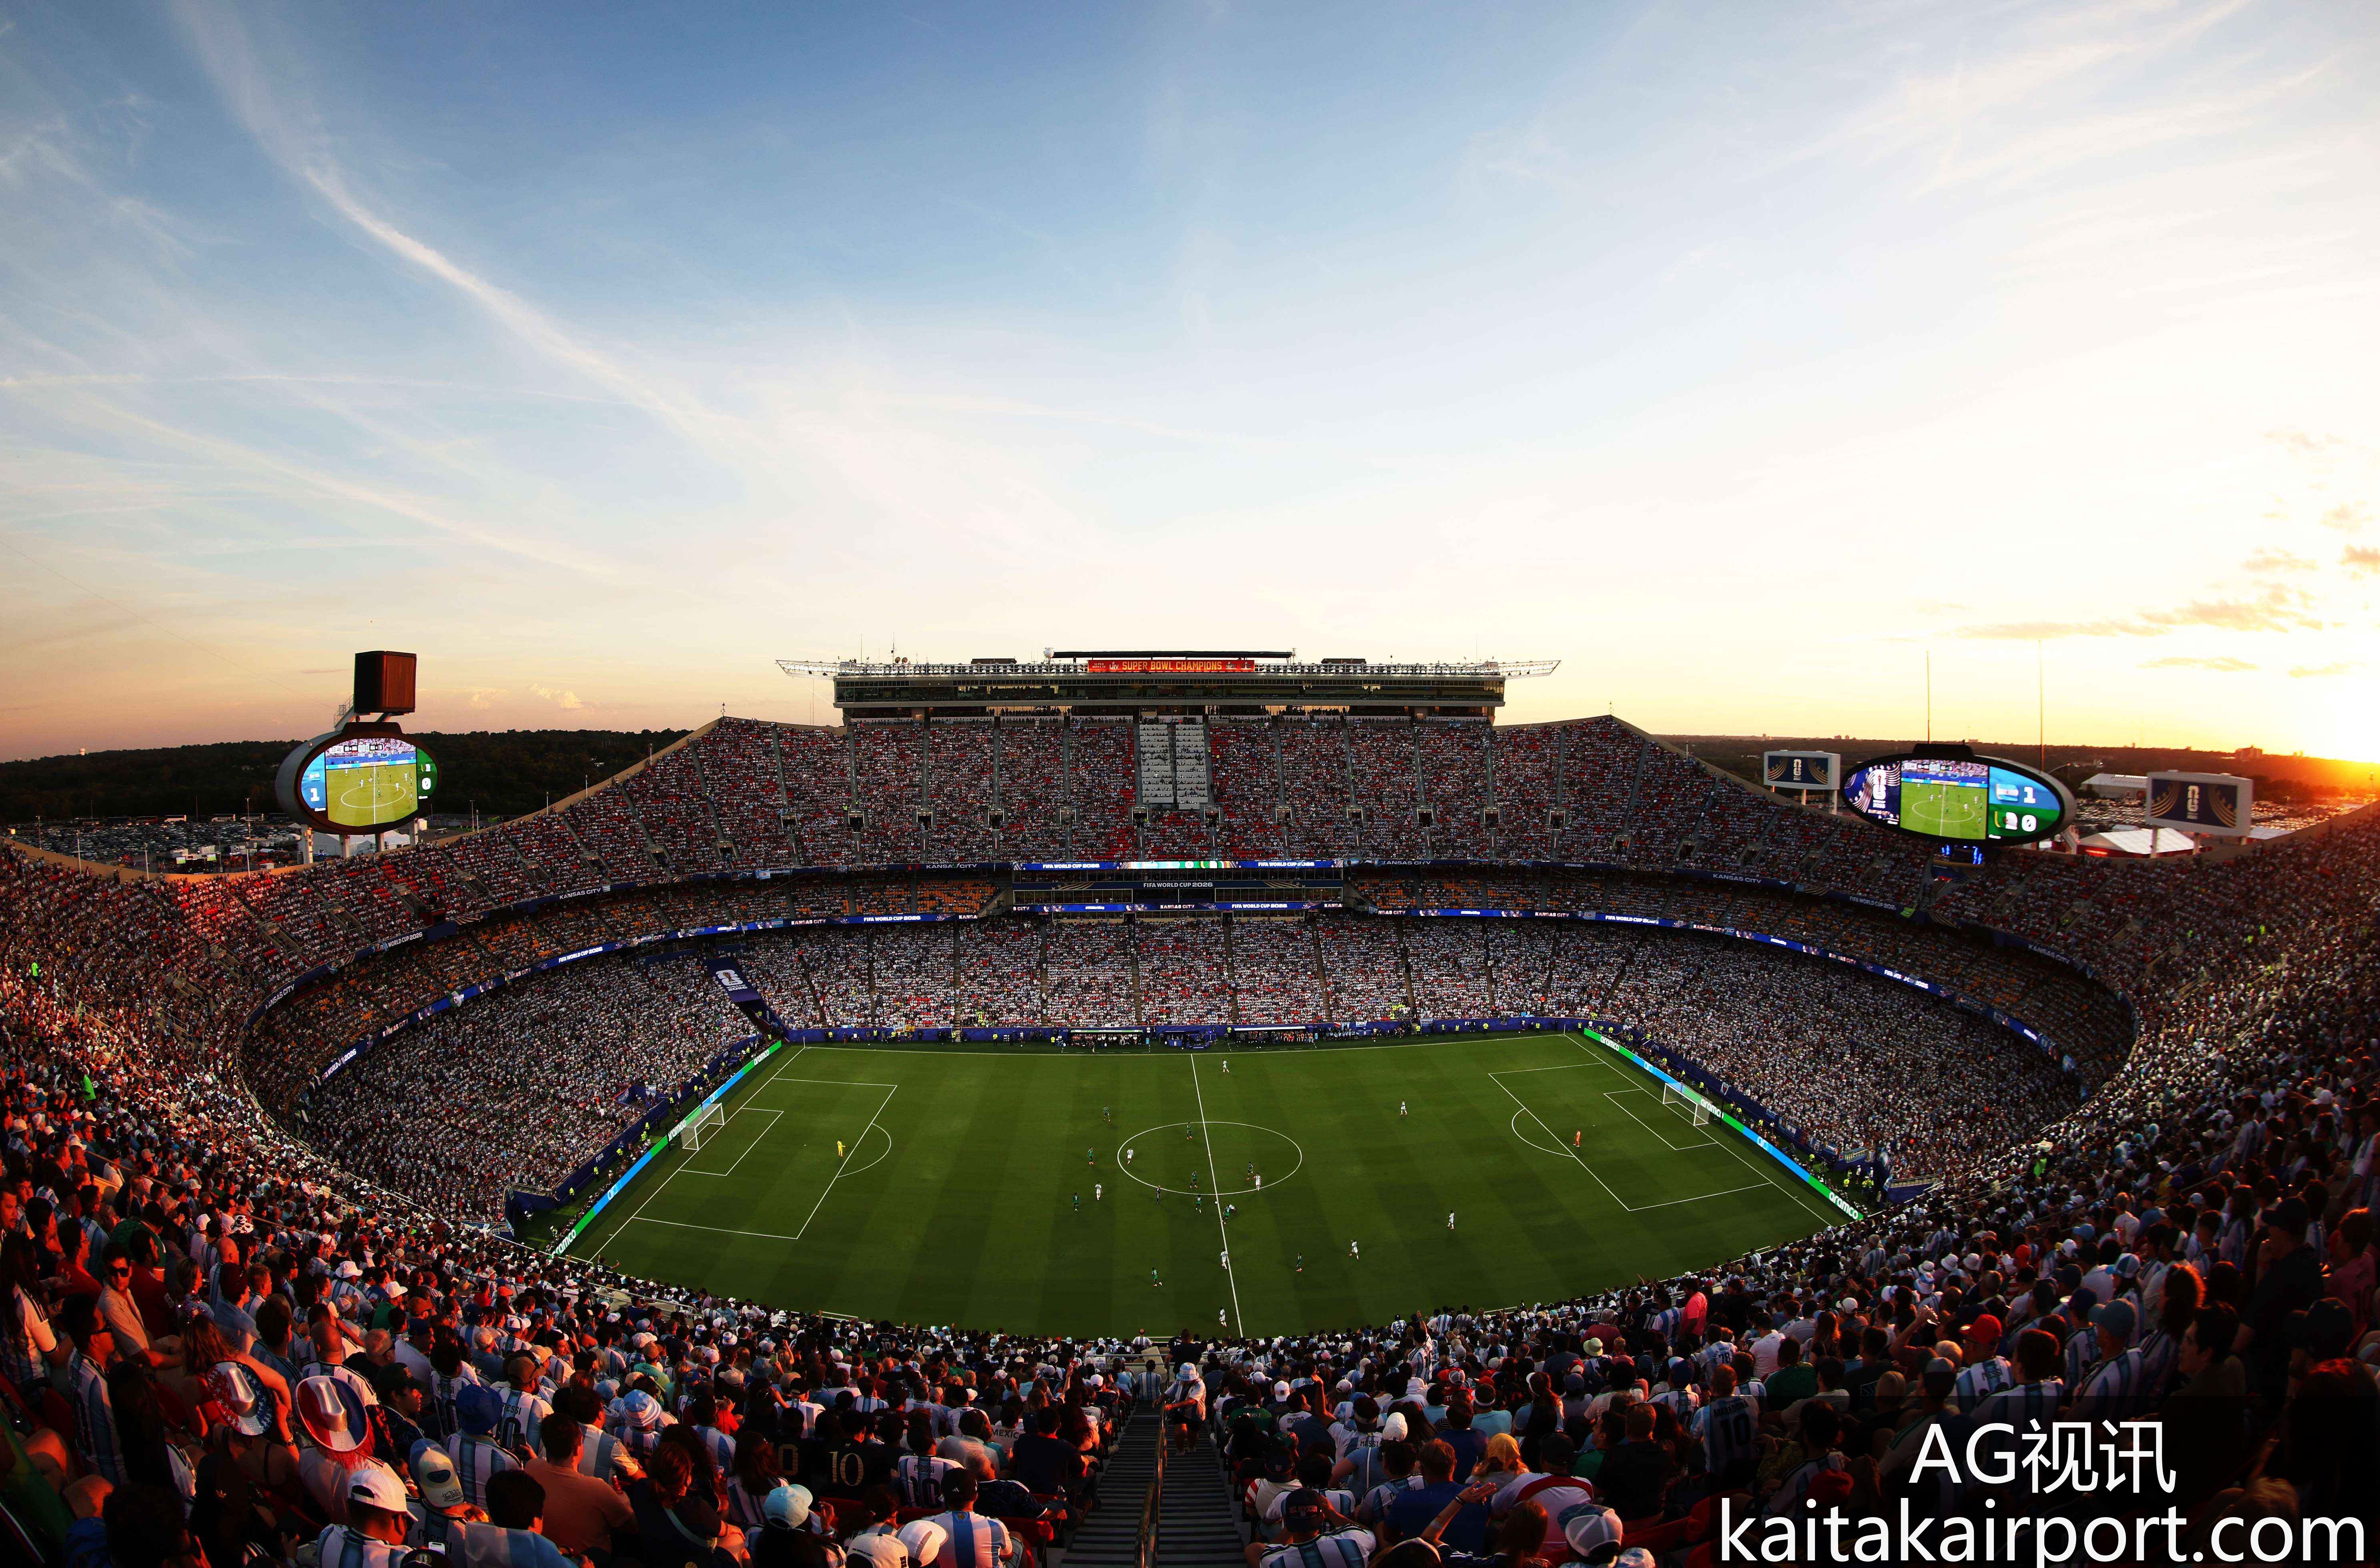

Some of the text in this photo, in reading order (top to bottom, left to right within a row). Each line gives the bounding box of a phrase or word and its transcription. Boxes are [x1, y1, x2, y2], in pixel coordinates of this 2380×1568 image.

[1122, 661, 1148, 670] SUPER
[1151, 661, 1173, 670] BOWL
[1176, 661, 1222, 670] CHAMPIONS
[422, 778, 431, 790] 0
[311, 788, 320, 801] 1
[2023, 787, 2036, 803] 1
[2022, 815, 2037, 832] 0
[1713, 873, 1743, 881] KANSAS
[560, 891, 585, 899] KANSAS
[388, 939, 402, 948] WORLD
[567, 952, 581, 960] WORLD
[265, 984, 294, 1011] KANSAS CITY
[1600, 1036, 1620, 1052] aramco
[344, 1049, 357, 1062] 2026
[754, 1050, 770, 1065] aramco
[1701, 1098, 1724, 1120] aramco
[596, 1153, 604, 1162] FIFA
[1829, 1191, 1859, 1220] aramco
[1714, 1400, 1749, 1417] MARADONA
[1720, 1412, 1751, 1450] 10
[829, 1451, 864, 1486] 10
